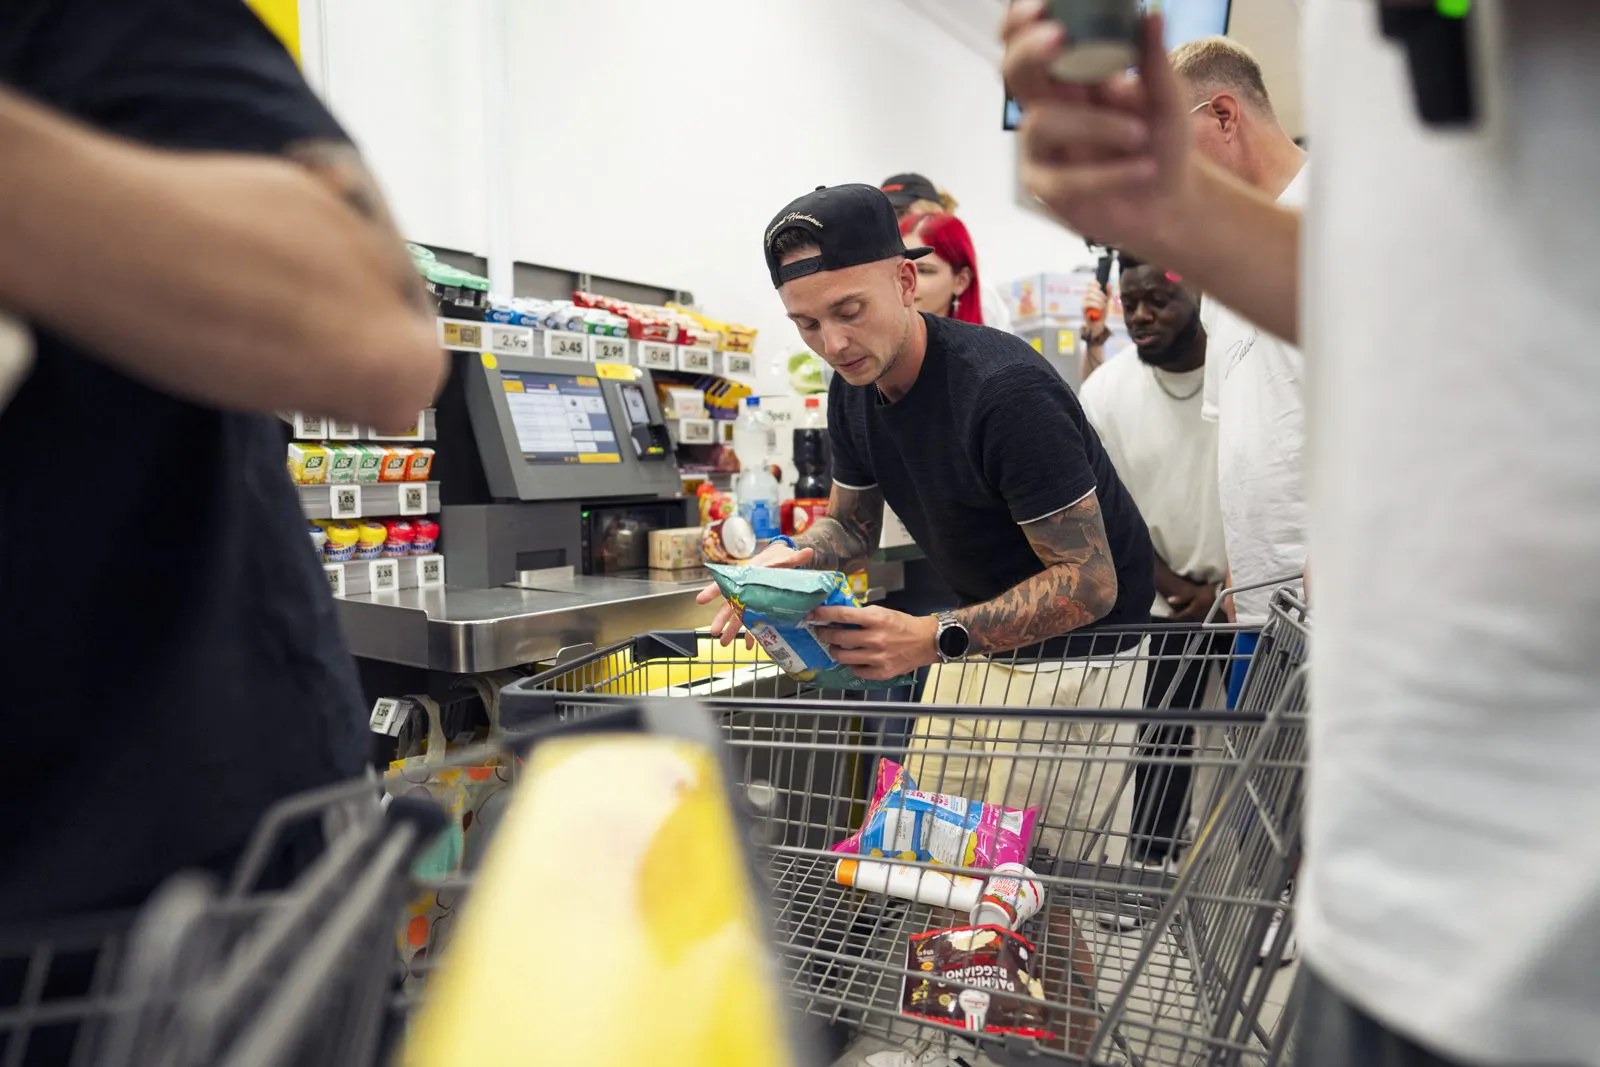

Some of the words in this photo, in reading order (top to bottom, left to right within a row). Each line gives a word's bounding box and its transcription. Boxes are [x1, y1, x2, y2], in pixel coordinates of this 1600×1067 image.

[559, 341, 582, 353] 3.45
[338, 495, 355, 503] 1.85
[946, 965, 1008, 980] REGGIANO
[937, 976, 1015, 992] PARMIGI
